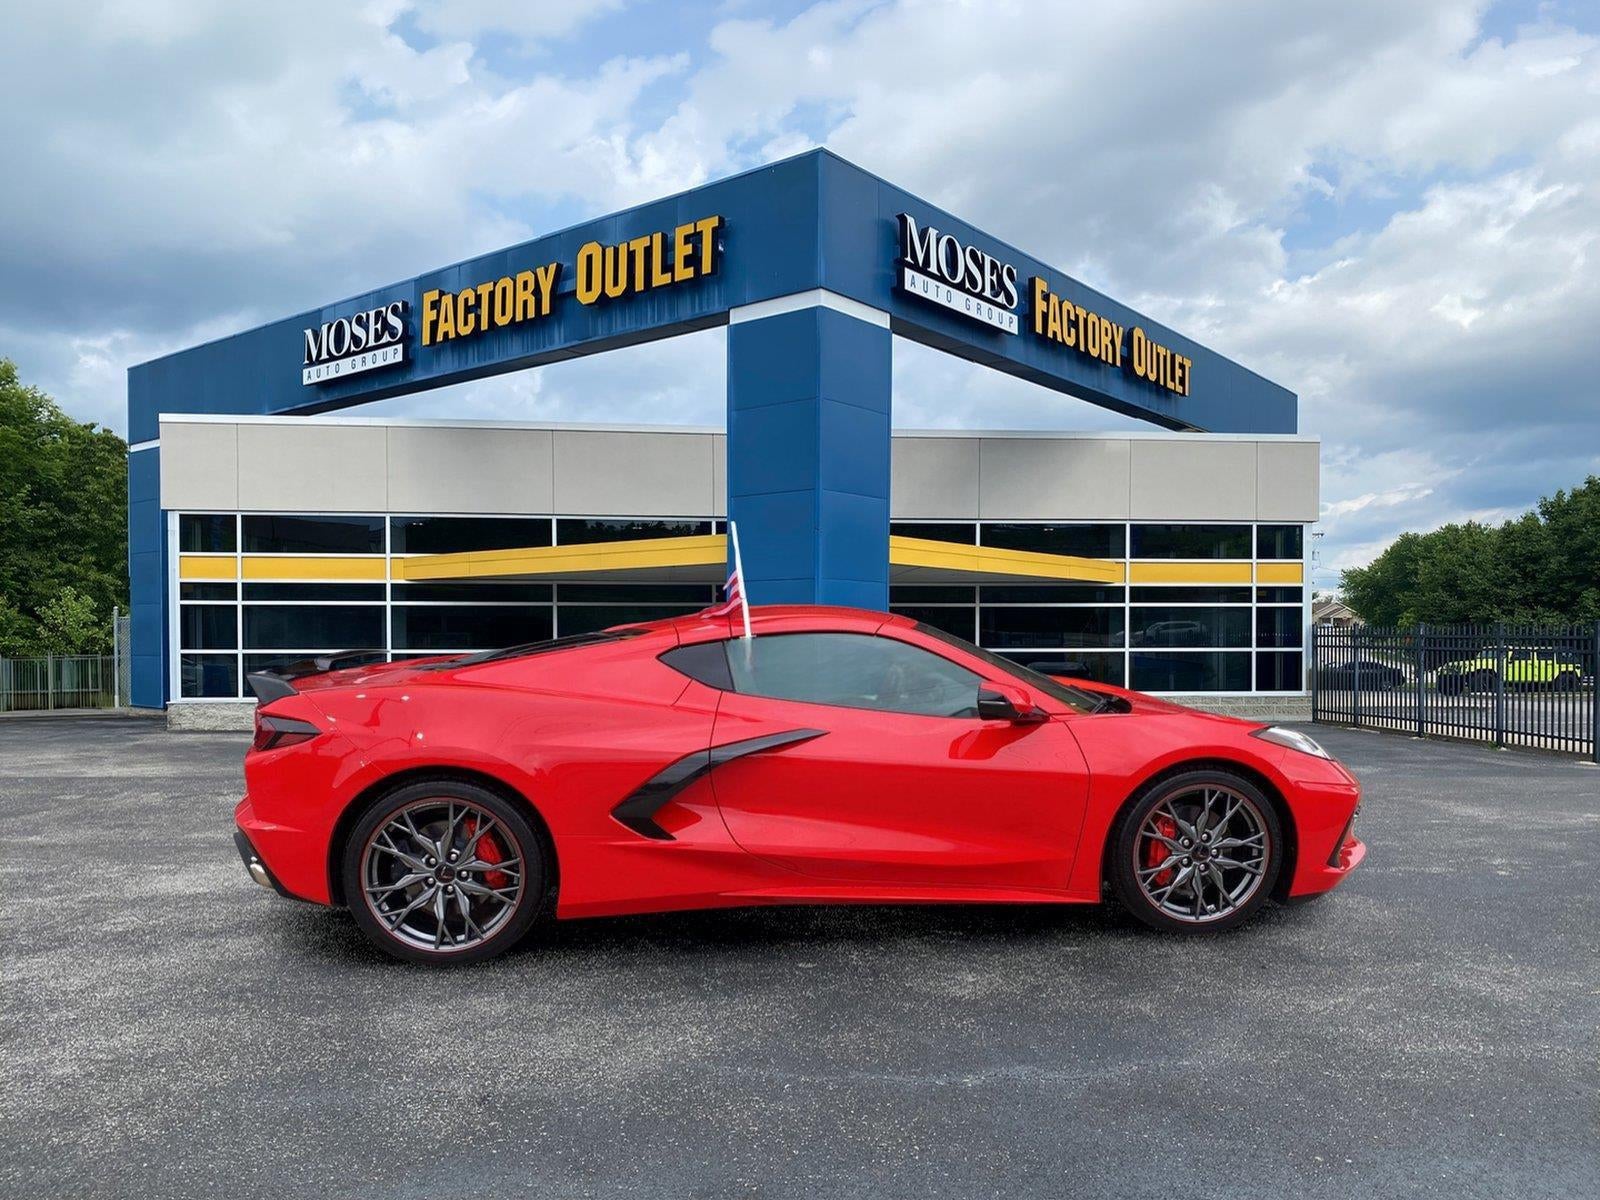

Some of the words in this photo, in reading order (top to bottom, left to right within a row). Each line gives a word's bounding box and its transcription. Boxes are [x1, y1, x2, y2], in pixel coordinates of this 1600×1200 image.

[422, 262, 558, 346] FACTORY
[576, 215, 719, 305] OUTLET
[904, 213, 1019, 310] MOSES
[910, 274, 952, 303] AUTO
[965, 298, 1014, 327] GROUP
[303, 301, 404, 365] MOSES
[307, 364, 340, 381] AUTO
[350, 348, 399, 370] GROUP
[1034, 276, 1124, 368] FACTORY
[1133, 326, 1191, 397] OUTLET
